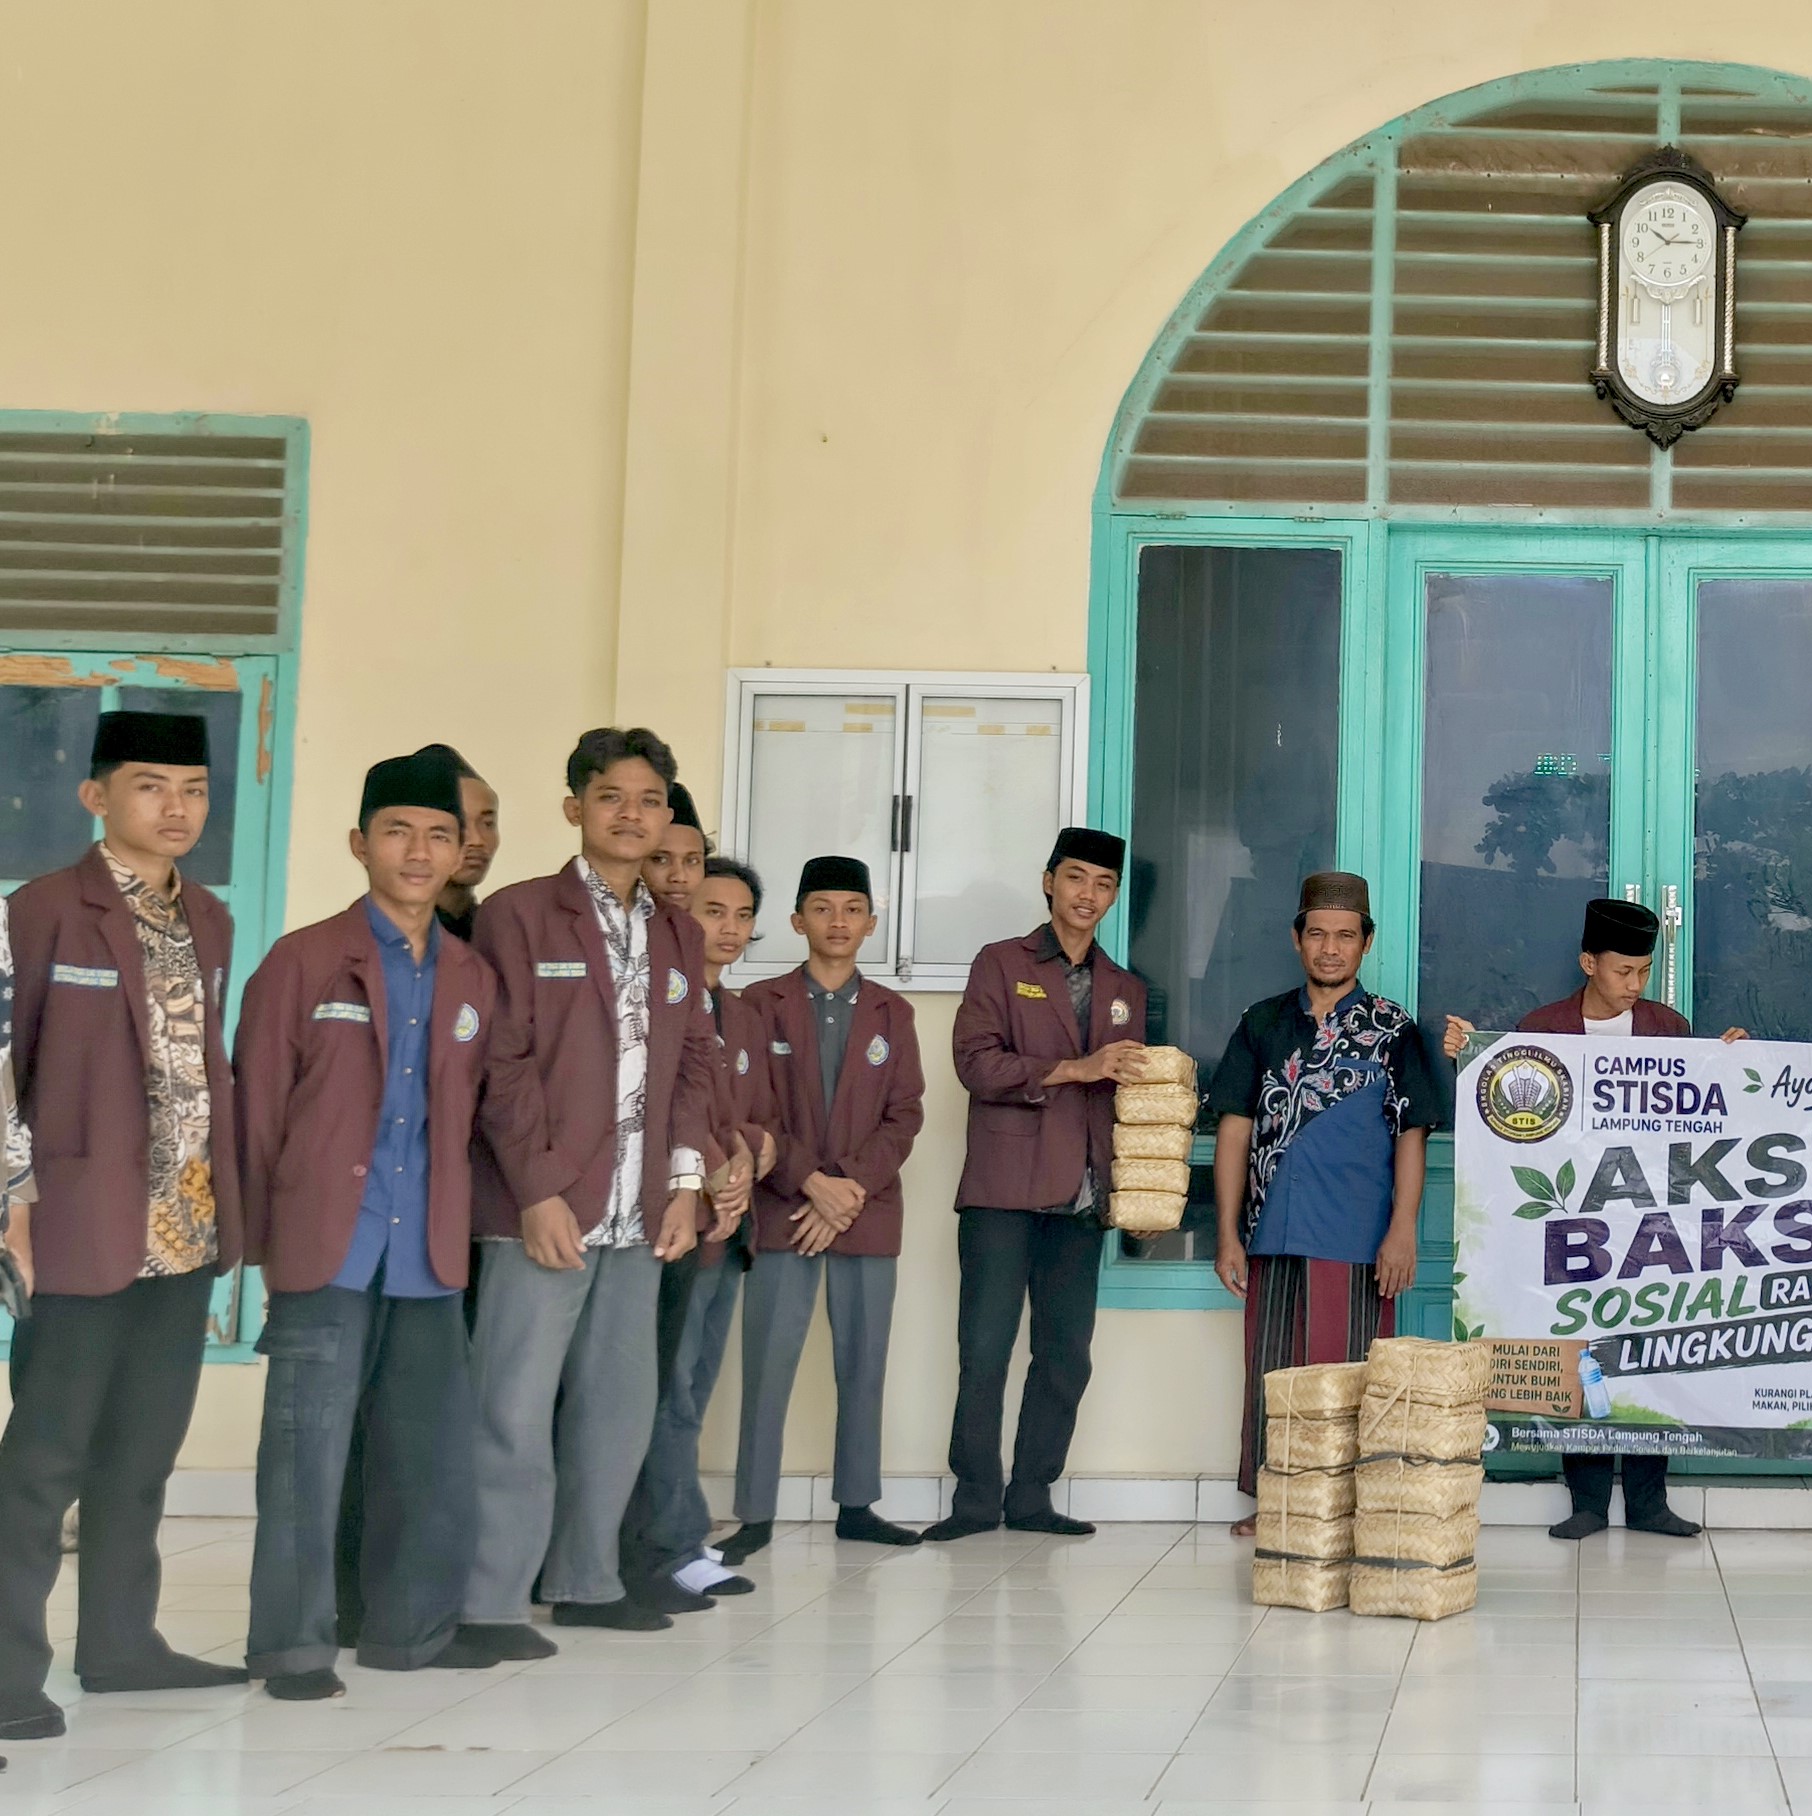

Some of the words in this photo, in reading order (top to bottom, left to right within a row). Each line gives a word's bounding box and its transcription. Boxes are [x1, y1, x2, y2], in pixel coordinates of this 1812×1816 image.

[1649, 211, 1657, 221] 11
[1662, 208, 1674, 218] 12
[1636, 223, 1648, 233] 10
[1692, 224, 1698, 234] 2
[1632, 238, 1639, 248] 9
[1697, 239, 1704, 248] 3
[1637, 252, 1644, 262] 8
[1691, 254, 1698, 263] 4
[1649, 265, 1655, 274] 7
[1664, 268, 1671, 278] 6
[1680, 265, 1687, 274] 5
[1595, 1056, 1685, 1077] CAMPUS
[1592, 1079, 1728, 1116] STISDA
[1592, 1118, 1661, 1131] LAMPUNG
[1666, 1120, 1722, 1134] TENGAH
[1550, 1275, 1757, 1335] SOSIAL
[1493, 1344, 1528, 1355] MULAI
[1533, 1346, 1560, 1357] DARI
[1490, 1359, 1510, 1369] DIRI
[1515, 1360, 1563, 1373] SENDIRI,
[1531, 1375, 1560, 1386] BUMI
[1487, 1389, 1506, 1398] NG
[1510, 1390, 1541, 1400] LEBIH
[1546, 1391, 1572, 1402] BAIK
[1754, 1388, 1797, 1398] KURANGI
[1752, 1401, 1789, 1411] MAKAN,
[1512, 1427, 1559, 1438] Bersama
[1563, 1428, 1606, 1439] STISDA
[1609, 1429, 1659, 1442] Lampung
[1663, 1431, 1702, 1444] Tengah
